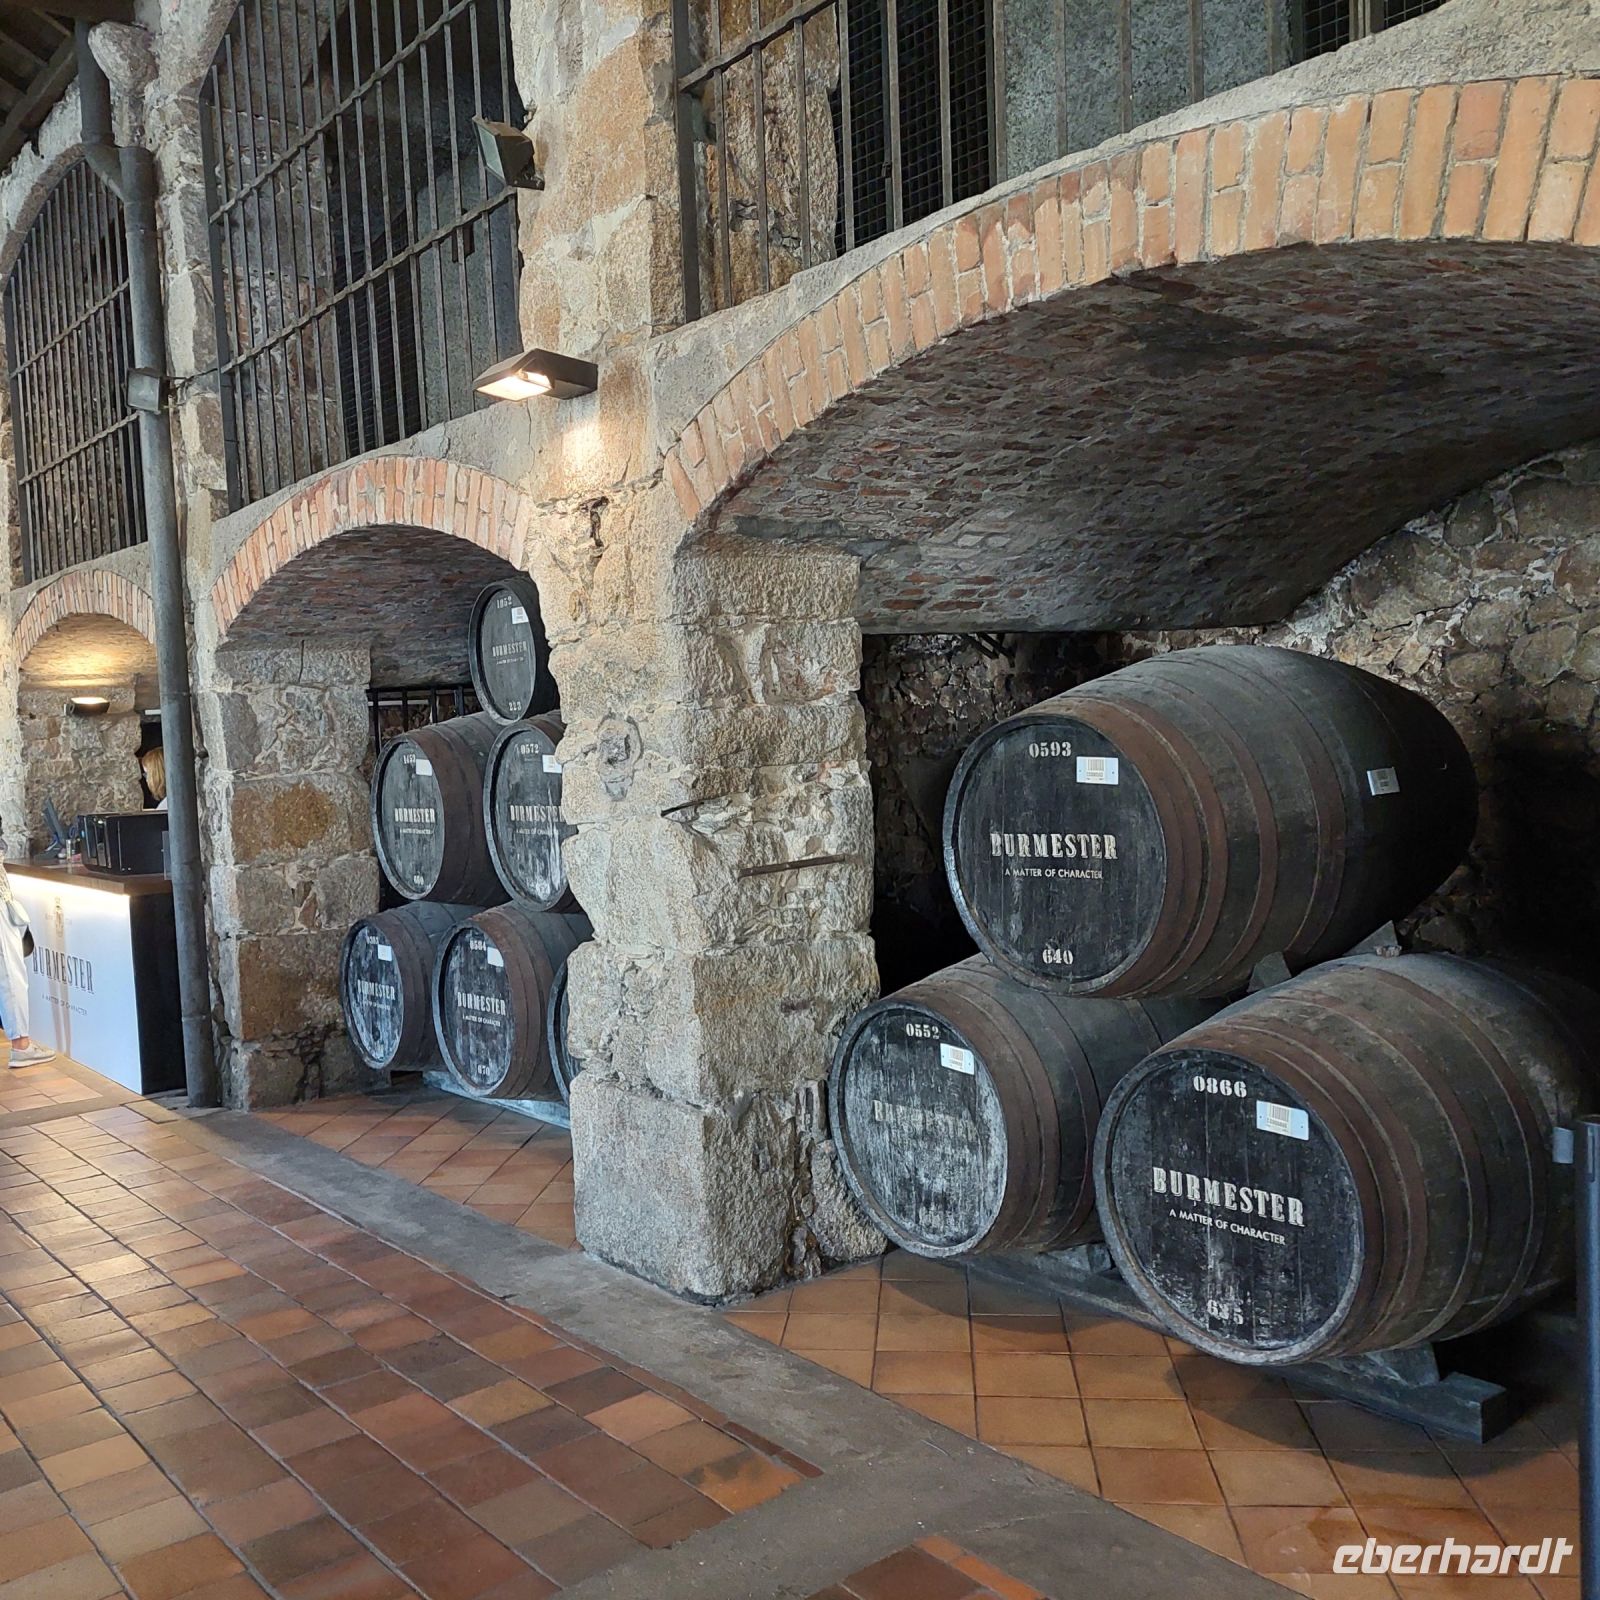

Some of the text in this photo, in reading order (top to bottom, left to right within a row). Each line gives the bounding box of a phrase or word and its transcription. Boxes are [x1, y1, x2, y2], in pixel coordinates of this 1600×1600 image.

[492, 641, 528, 657] BURMESTER
[520, 743, 539, 755] 0572
[1029, 741, 1072, 759] 0593
[394, 807, 436, 823] BURMESTER
[990, 832, 1118, 860] BURMESTER
[1004, 868, 1103, 880] A MATTER OF CHARACTER
[1042, 948, 1074, 965] 640
[33, 945, 95, 995] BURMESTER
[357, 979, 396, 1001] BURMESTER
[457, 991, 507, 1017] BURMESTER
[906, 1023, 940, 1040] 0552
[1193, 1075, 1247, 1098] 0866
[1152, 1166, 1305, 1228] BURMESTER
[1169, 1209, 1286, 1246] A MATTER OF CHARACTER
